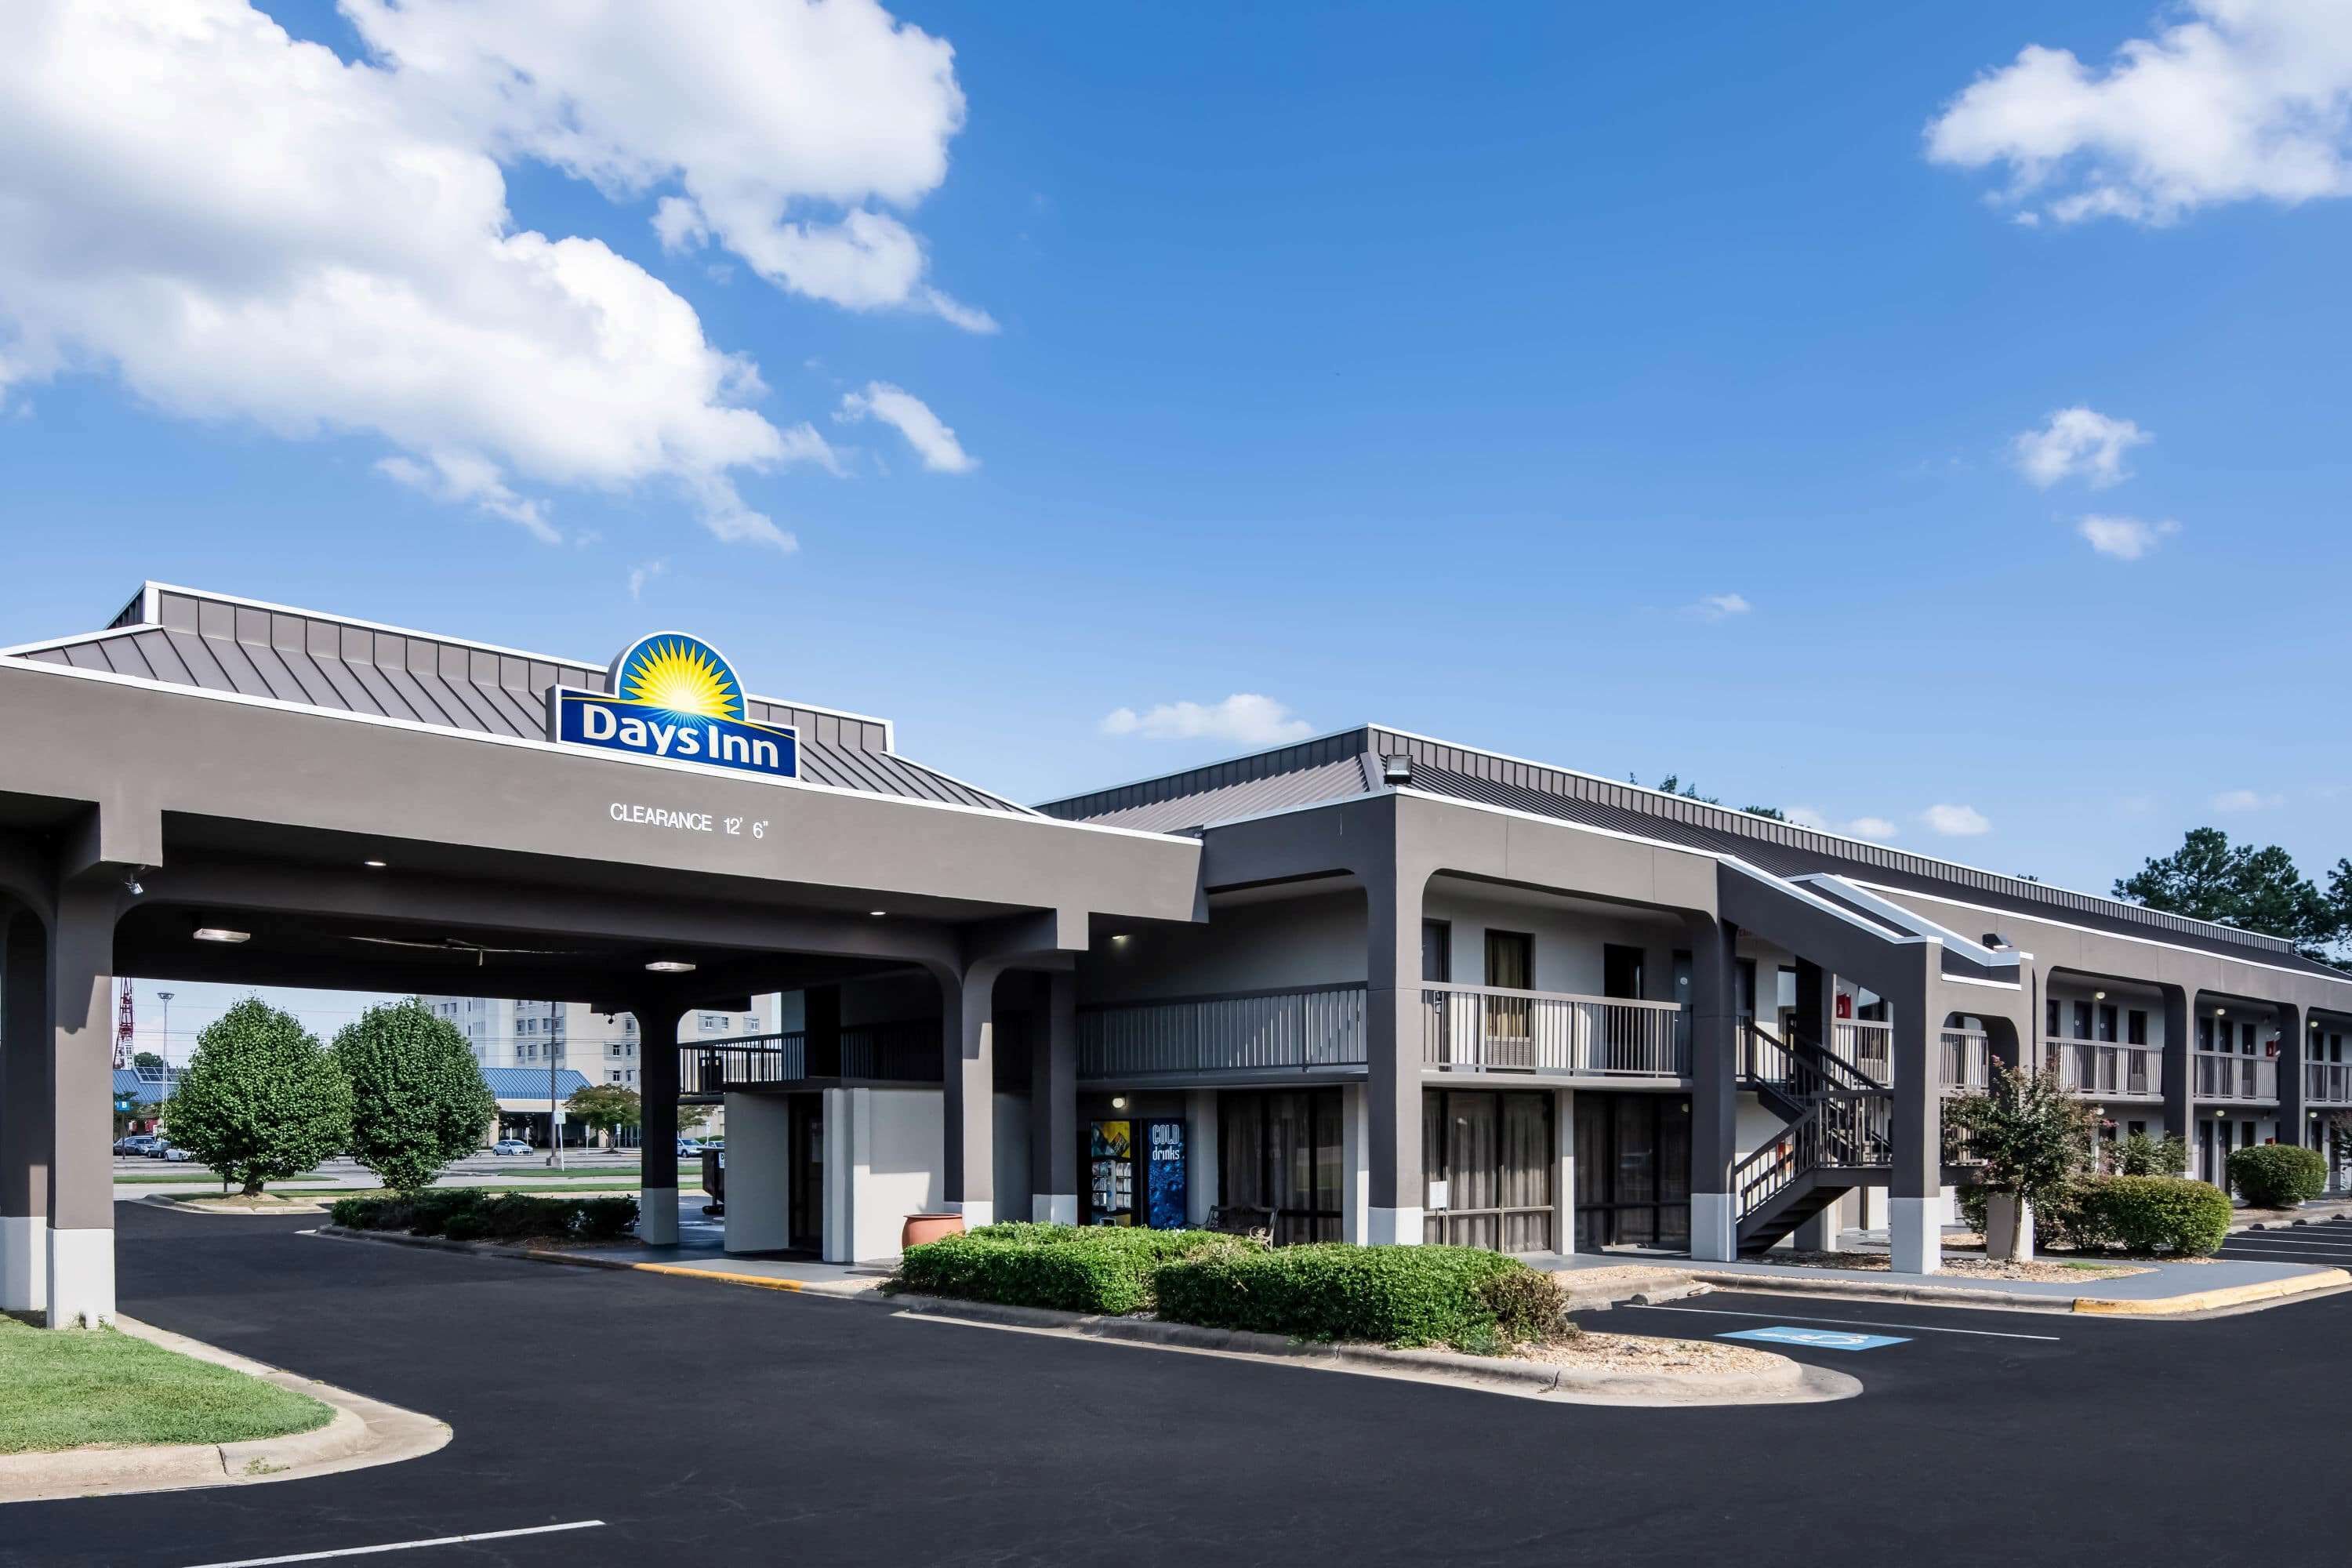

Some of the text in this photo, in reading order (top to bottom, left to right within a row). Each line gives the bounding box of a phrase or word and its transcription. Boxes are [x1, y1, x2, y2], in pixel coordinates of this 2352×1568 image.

[583, 703, 779, 768] Days Inn
[610, 803, 768, 839] CLEARANCE 12' 6"
[1152, 1124, 1180, 1145] COLD
[1152, 1146, 1180, 1160] drinks
